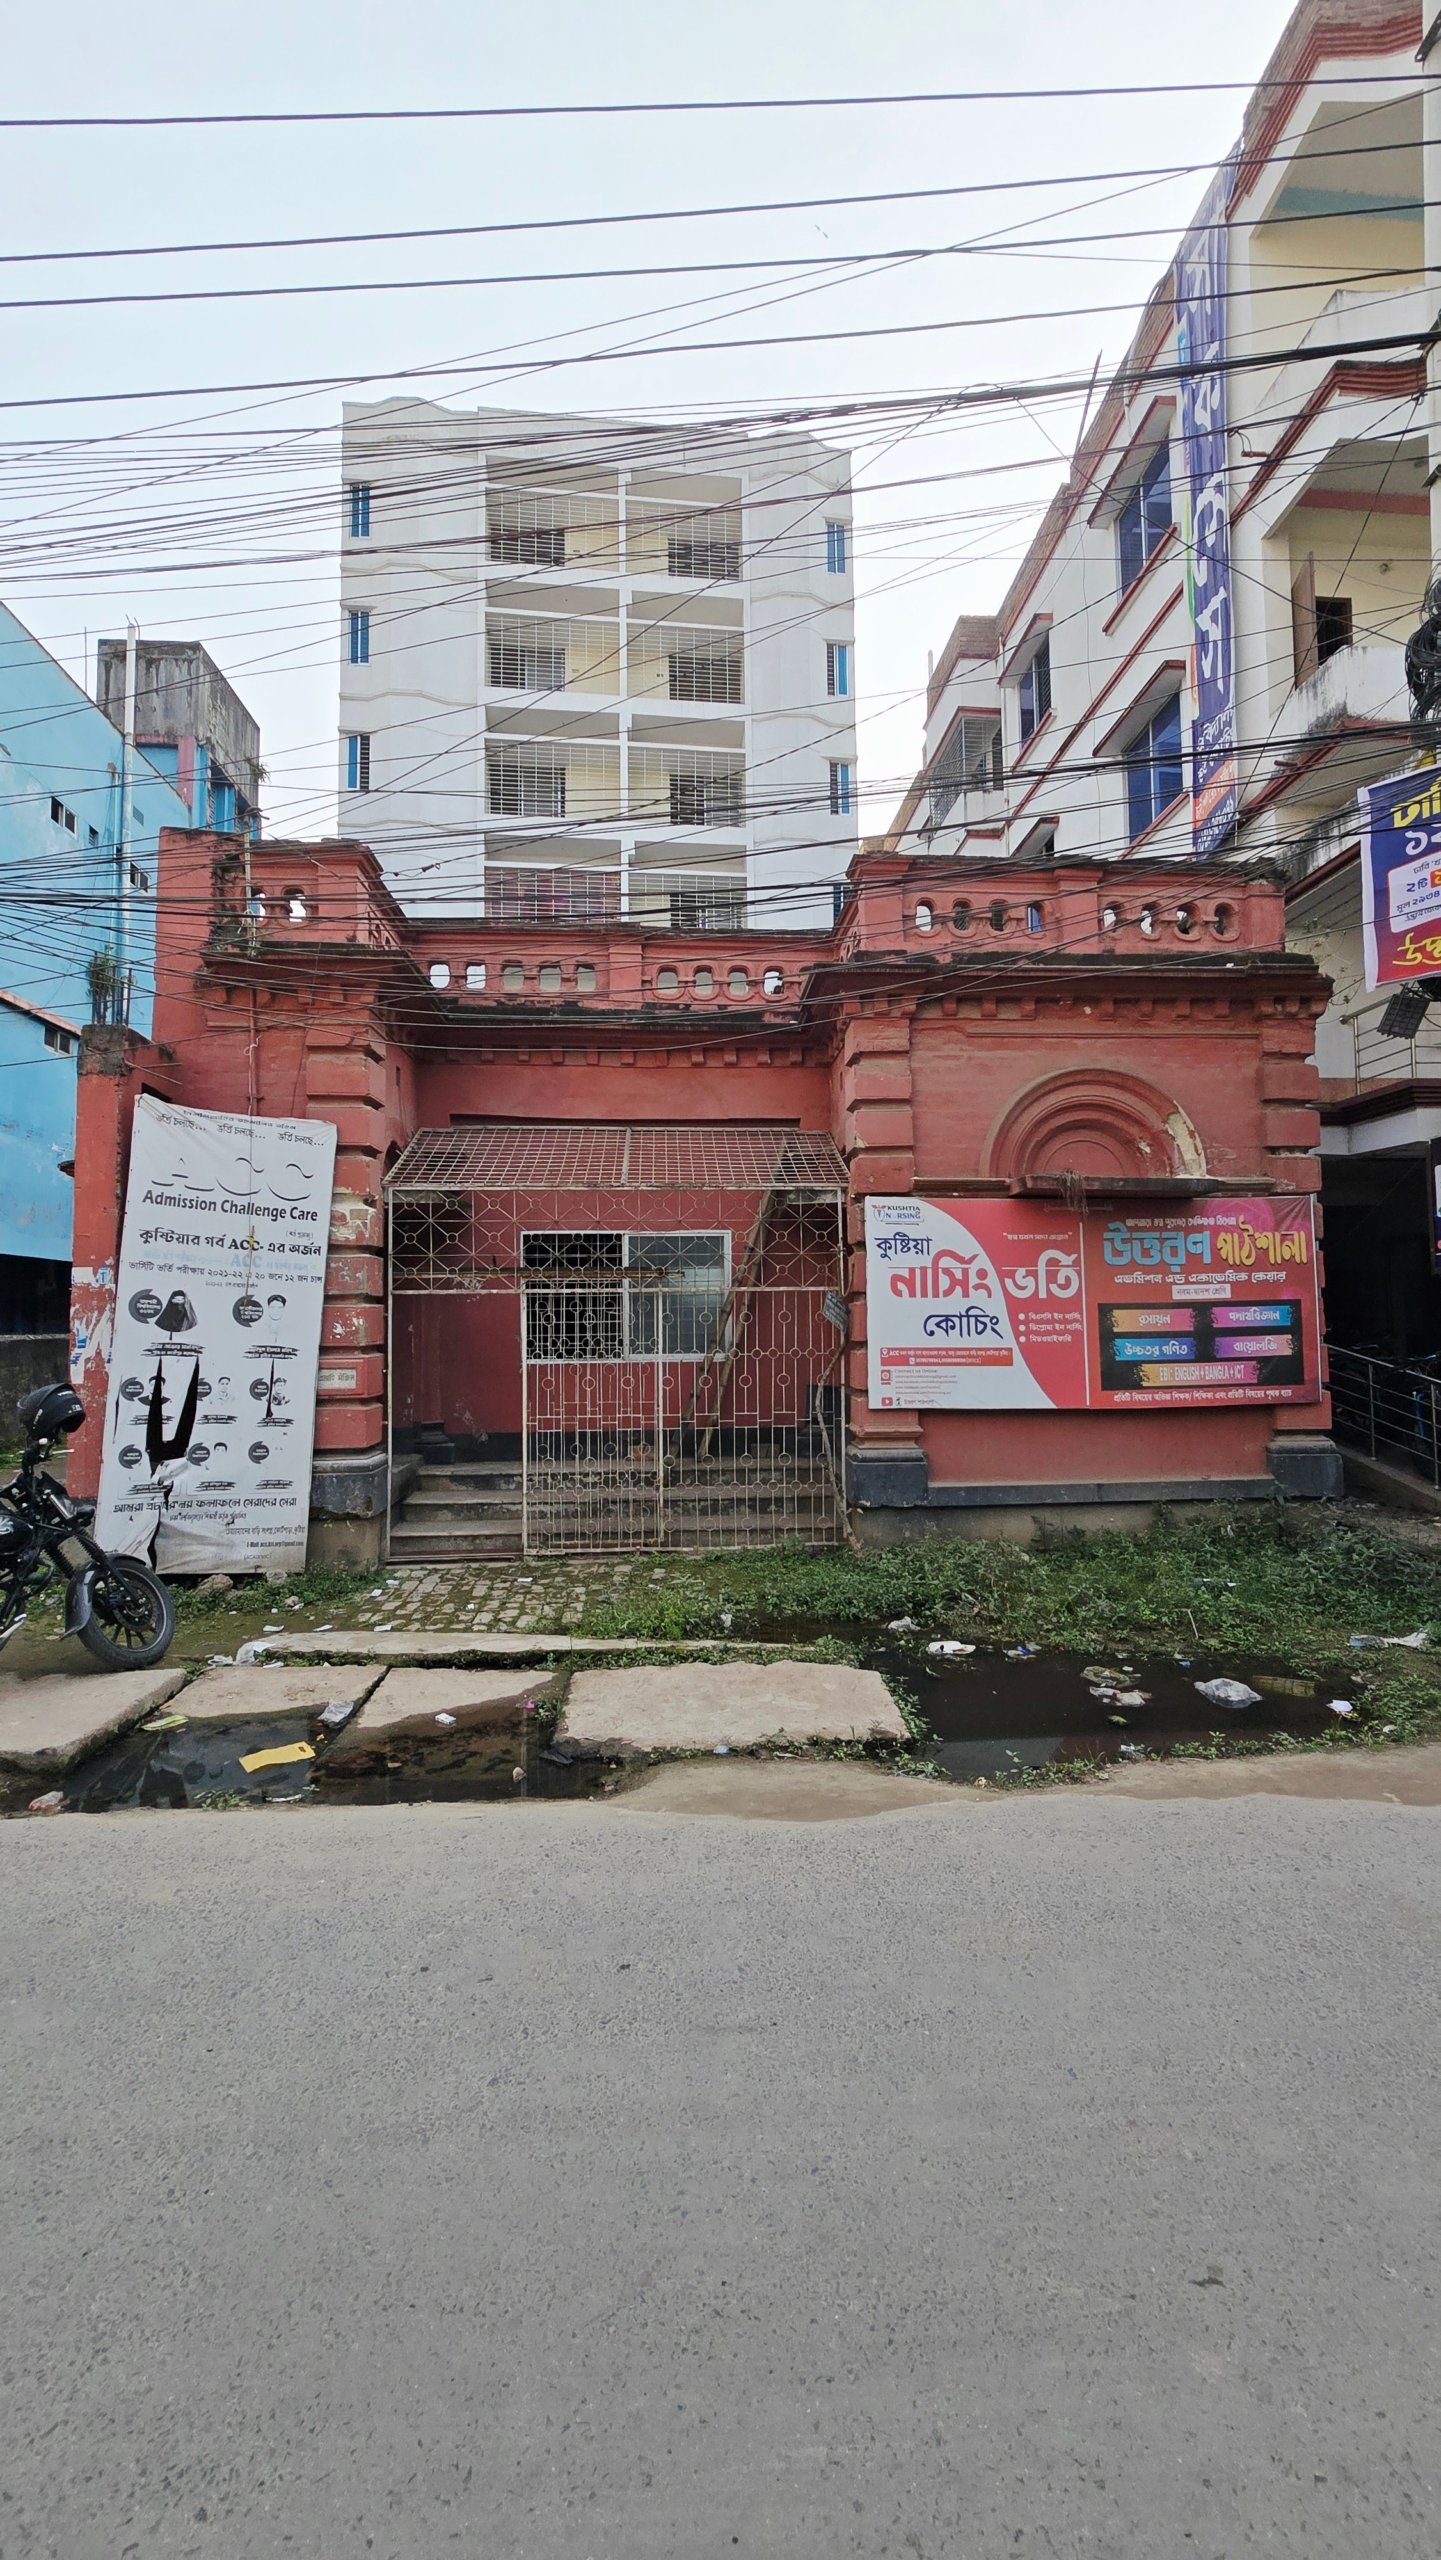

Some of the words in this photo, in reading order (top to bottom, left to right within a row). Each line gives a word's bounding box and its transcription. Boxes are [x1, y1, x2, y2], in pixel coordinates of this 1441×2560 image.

[1406, 883, 1416, 892] ২
[1417, 877, 1428, 890] টি
[142, 1188, 218, 1213] Admission
[221, 1198, 288, 1222] Challenge
[290, 1206, 318, 1222] Care
[139, 1226, 201, 1246] কুষ্টিয়ার
[205, 1233, 226, 1248] গর্ব
[267, 1242, 286, 1254] এর
[288, 1241, 322, 1257] অর্জন
[874, 1231, 933, 1261] কুষ্টিয়া
[1103, 1221, 1211, 1273] উত্তরণ
[1216, 1215, 1308, 1267] পাঠশালা
[157, 1263, 175, 1273] ভর্তি
[207, 1268, 244, 1279] ২০২১-২২
[254, 1272, 266, 1281] ২০
[285, 1275, 295, 1283] ১২
[888, 1248, 994, 1299] নার্সিং
[1001, 1249, 1079, 1299] ভর্তি
[1114, 1272, 1163, 1285] এডমিশন
[1251, 1271, 1287, 1284] কেয়ার
[923, 1305, 1003, 1340] কোচিং
[1138, 1314, 1172, 1327] রসায়ন
[1124, 1342, 1160, 1357] উচ্চতর
[1161, 1340, 1189, 1356] গণিত
[1232, 1336, 1279, 1354] বায়োলজি
[1175, 1365, 1200, 1380] ENGLISH
[1205, 1365, 1229, 1380] BANGLA
[1234, 1364, 1245, 1379] ICT
[113, 1502, 144, 1513] আমরা
[195, 1497, 241, 1509] ফলাফলে
[243, 1497, 277, 1509] সেরাদের
[279, 1497, 297, 1508] সেরা
